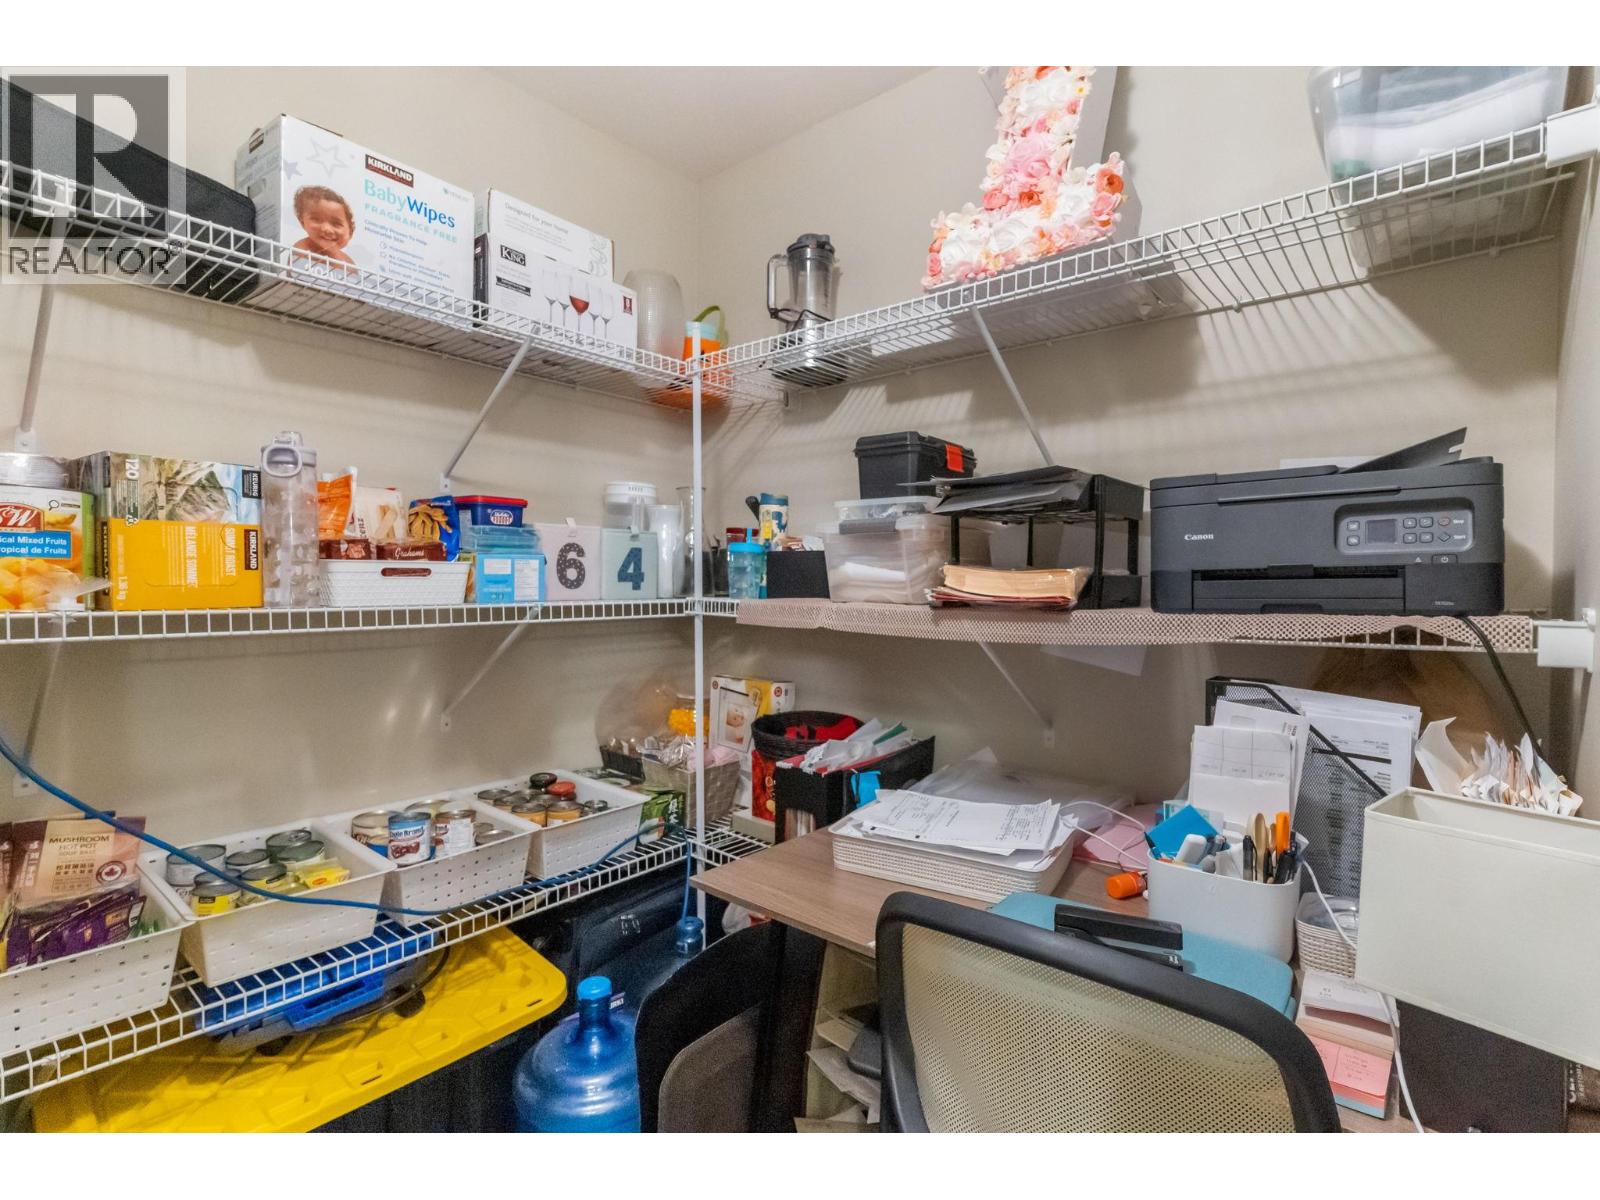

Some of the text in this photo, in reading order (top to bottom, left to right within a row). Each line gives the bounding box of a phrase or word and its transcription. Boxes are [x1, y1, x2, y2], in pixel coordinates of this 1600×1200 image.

[367, 156, 413, 182] KIRKLAND
[364, 203, 457, 243] FRAGRANCE FREE
[125, 459, 139, 479] 120
[0, 506, 38, 526] &W
[0, 546, 28, 555] opical
[44, 547, 67, 555] Fruits
[17, 536, 44, 544] Mixed
[45, 537, 67, 545] Fruits
[249, 531, 257, 569] KIRKLAND
[394, 548, 425, 560] Grahams
[225, 555, 236, 576] ROAST
[557, 543, 586, 590] 6
[618, 547, 644, 590] 4
[49, 835, 110, 843] MUSHROOM
